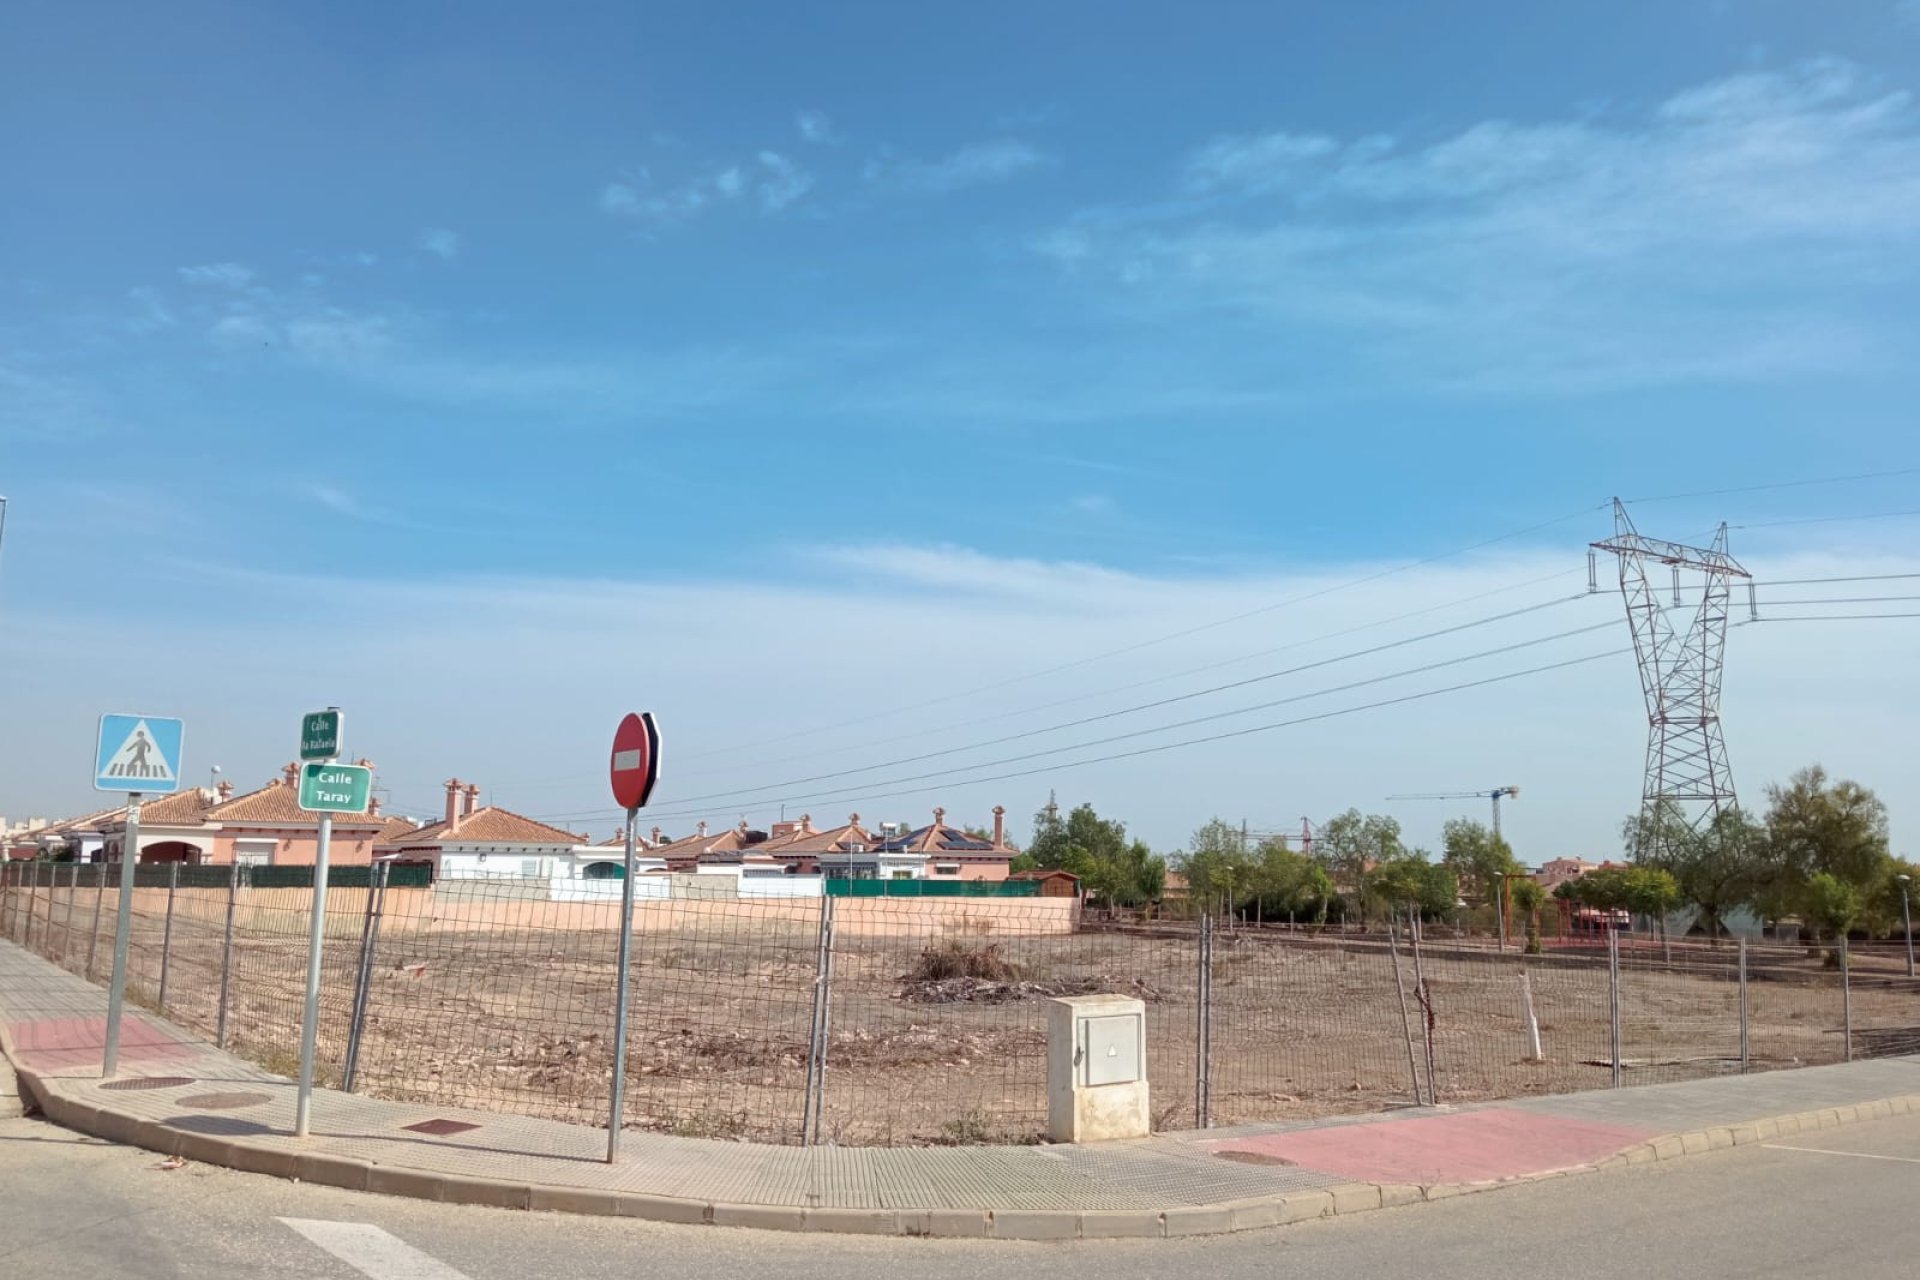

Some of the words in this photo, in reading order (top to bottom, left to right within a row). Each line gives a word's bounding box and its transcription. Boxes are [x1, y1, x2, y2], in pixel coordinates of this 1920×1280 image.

[311, 720, 329, 731] Calle
[319, 772, 353, 784] Calle
[316, 790, 352, 804] Taray
